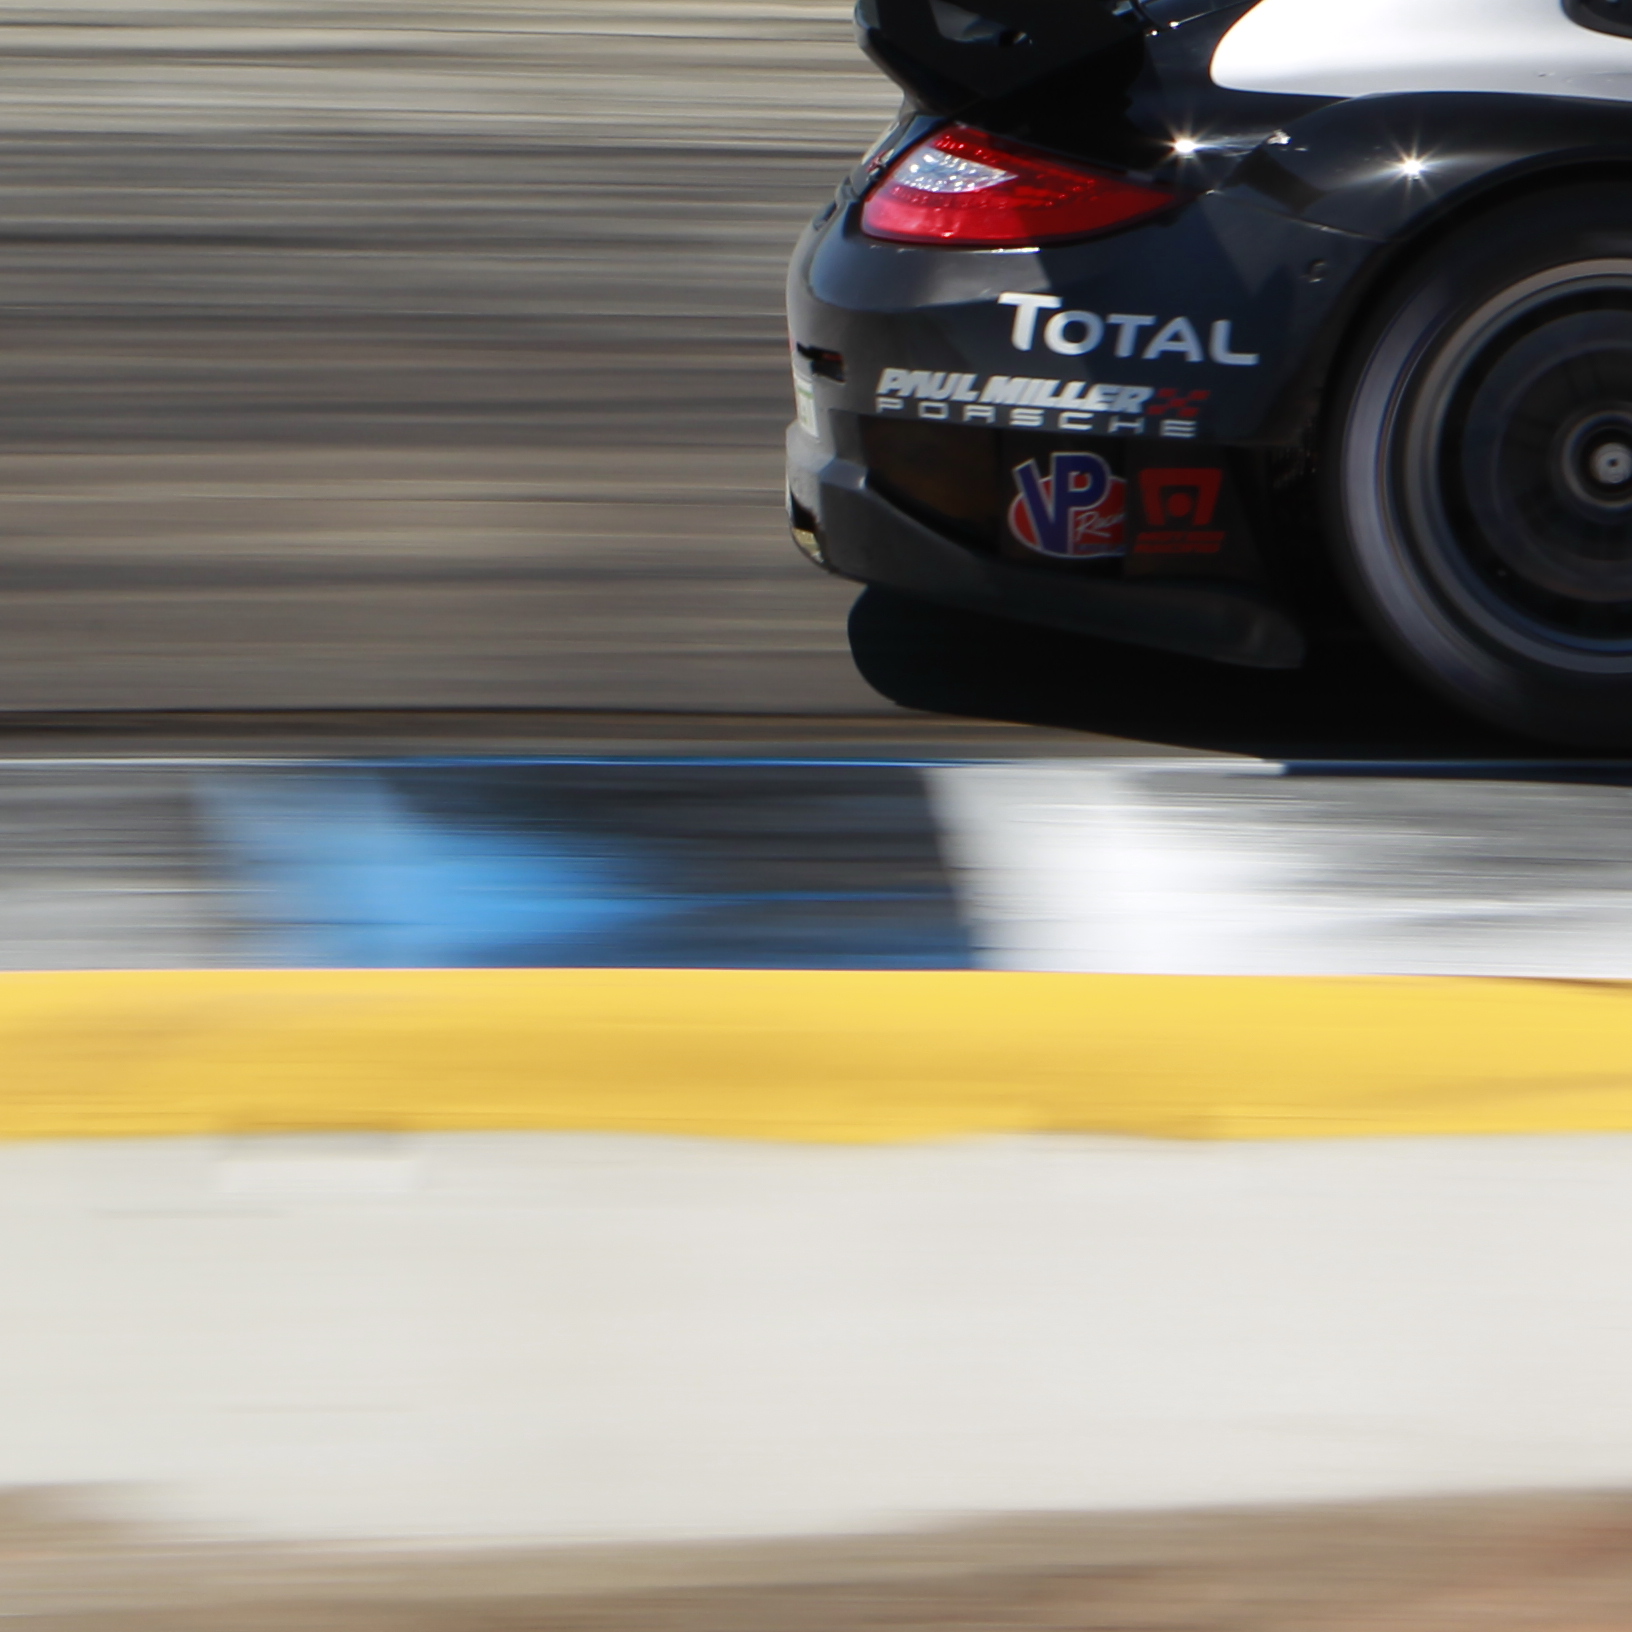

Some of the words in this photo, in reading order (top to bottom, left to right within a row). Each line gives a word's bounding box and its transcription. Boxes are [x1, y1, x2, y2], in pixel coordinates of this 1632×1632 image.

[998, 292, 1260, 366] TOTAL
[876, 368, 978, 402] PAUL
[979, 374, 1155, 414] MILLER
[876, 397, 1198, 438] PORSCHE
[1011, 451, 1112, 557] VP
